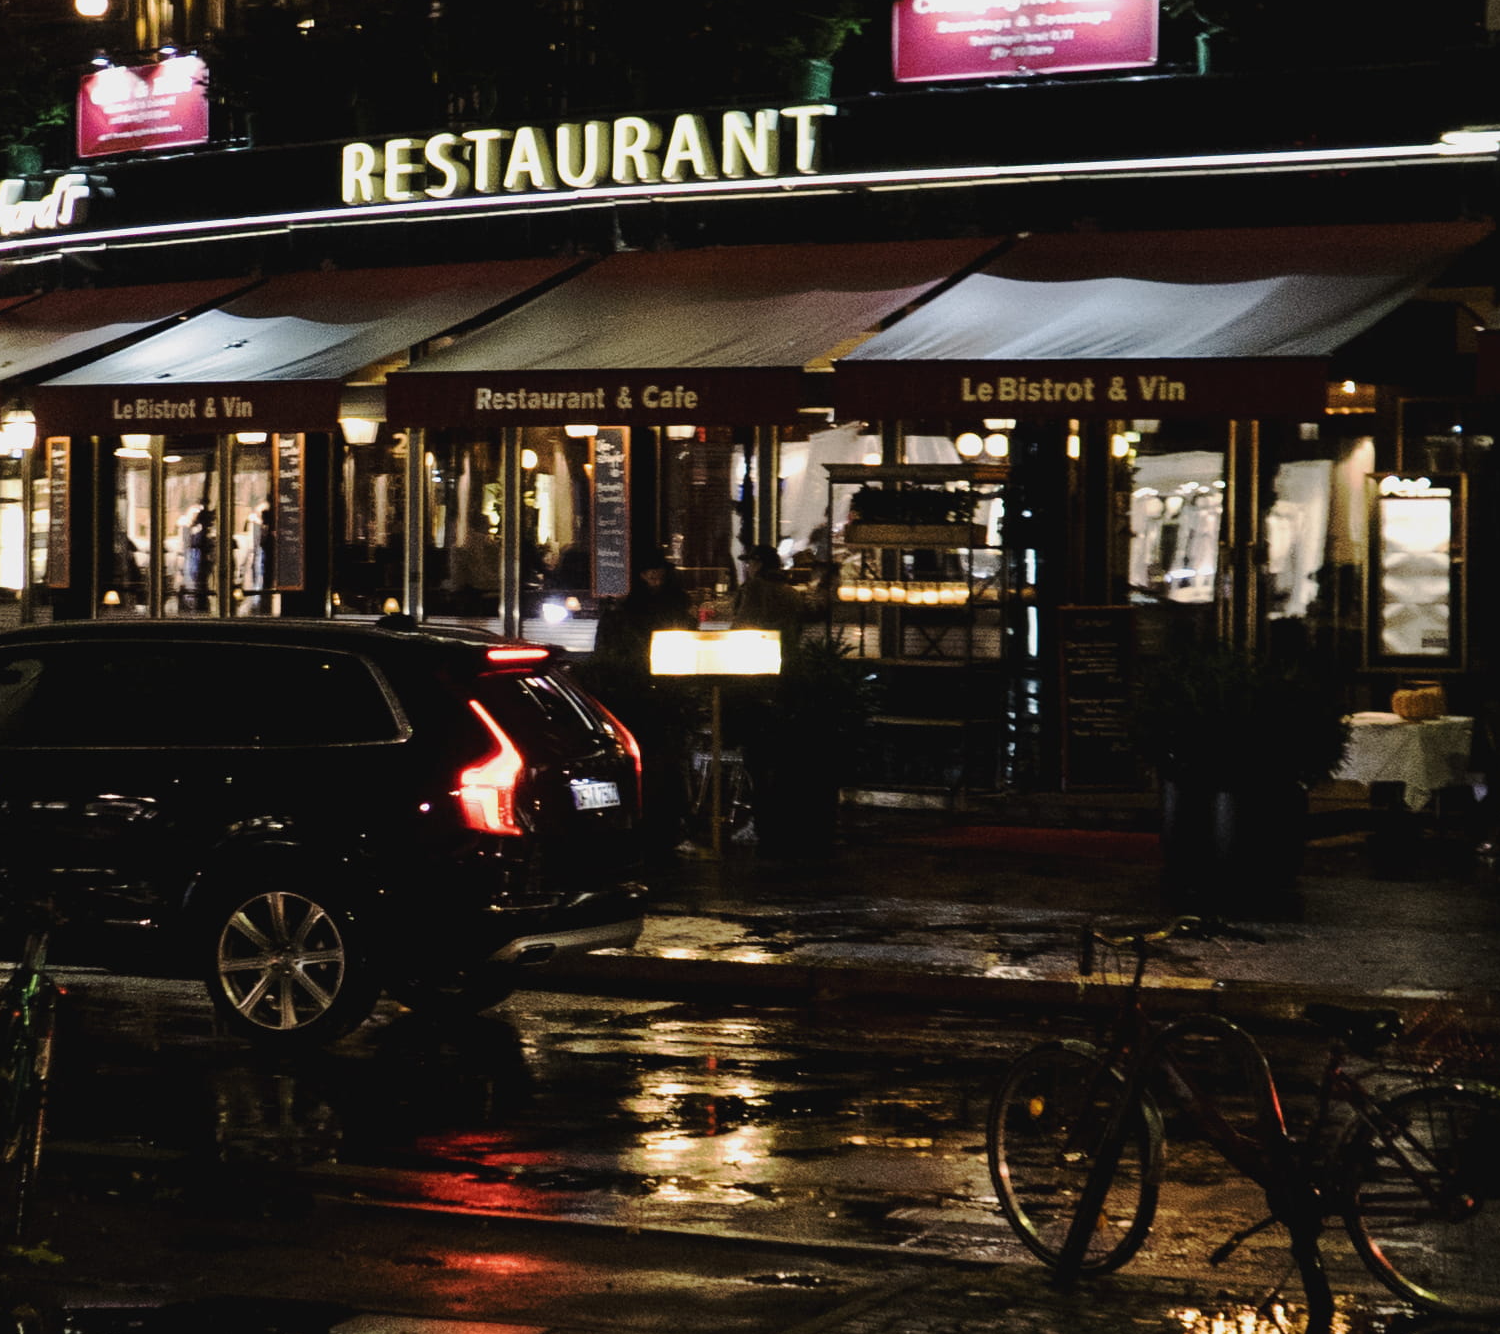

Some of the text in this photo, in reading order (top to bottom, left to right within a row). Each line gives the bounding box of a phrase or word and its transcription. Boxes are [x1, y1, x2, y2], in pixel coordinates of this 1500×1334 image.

[341, 103, 836, 205] RESTAURANT
[475, 385, 698, 411] Restaurant & Cafe
[1107, 376, 1128, 402] &
[1138, 375, 1186, 401] Vin
[203, 396, 217, 419] &
[222, 396, 253, 418] Vin
